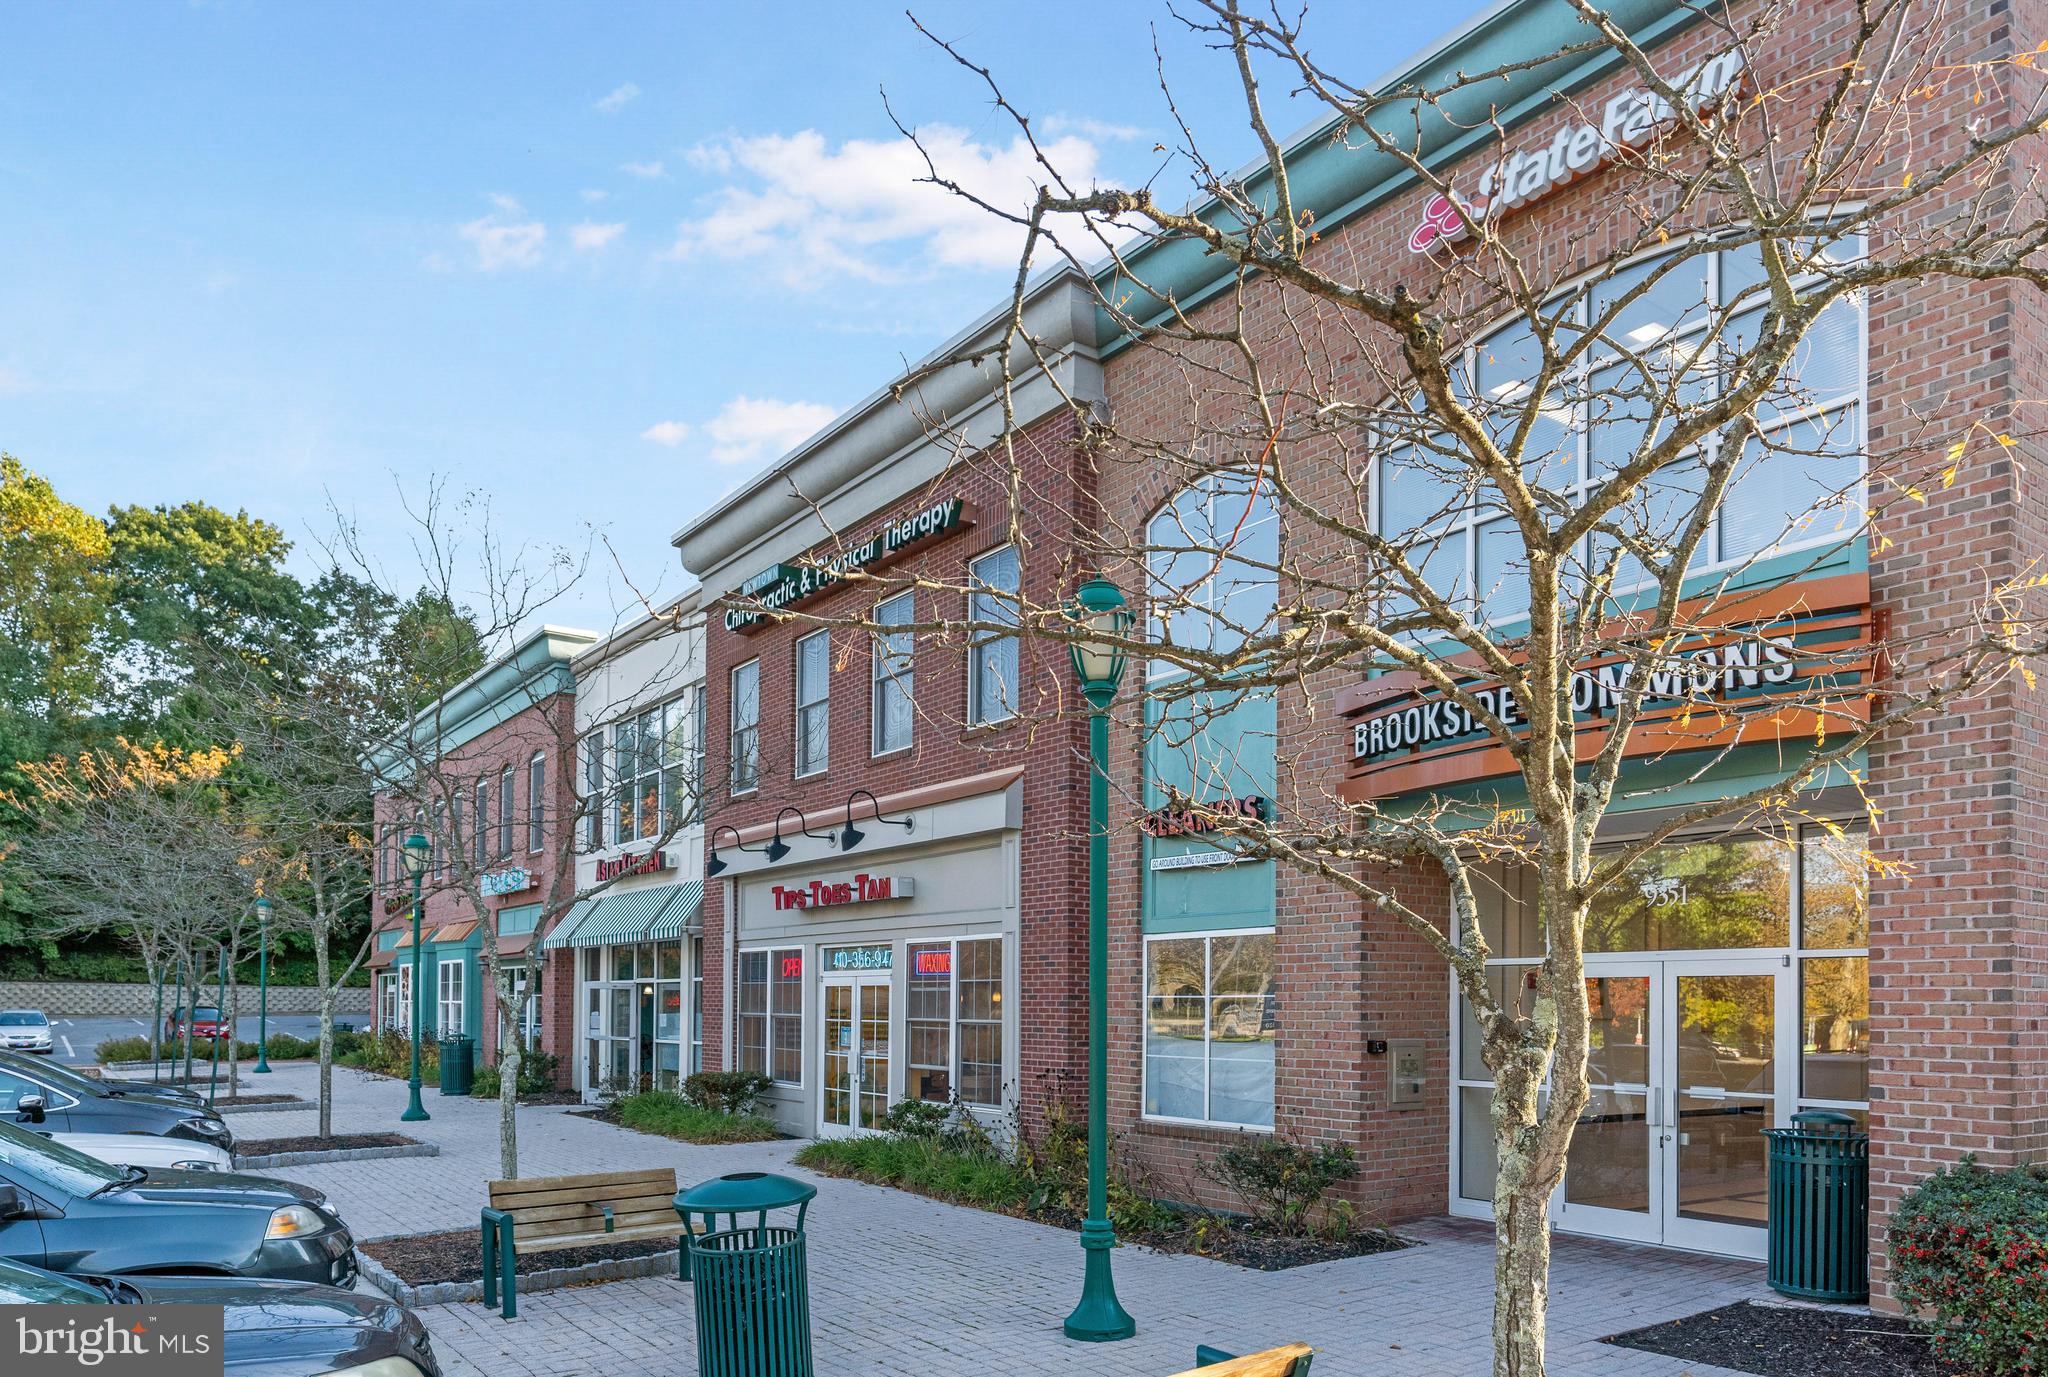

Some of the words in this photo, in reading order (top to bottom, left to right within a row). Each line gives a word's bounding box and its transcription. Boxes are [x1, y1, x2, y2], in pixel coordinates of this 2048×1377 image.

[800, 566, 811, 594] &
[882, 497, 953, 550] Therapy
[1354, 686, 1518, 759] BROOKSIDE
[1569, 637, 1795, 713] OMMONS
[1152, 859, 1158, 869] GO
[1159, 858, 1176, 868] AROUND
[1176, 855, 1195, 866] BUILDING
[1201, 854, 1209, 864] USE
[1210, 852, 1224, 863] FRONT
[1645, 884, 1688, 908] 9351
[918, 952, 951, 974] WAXING
